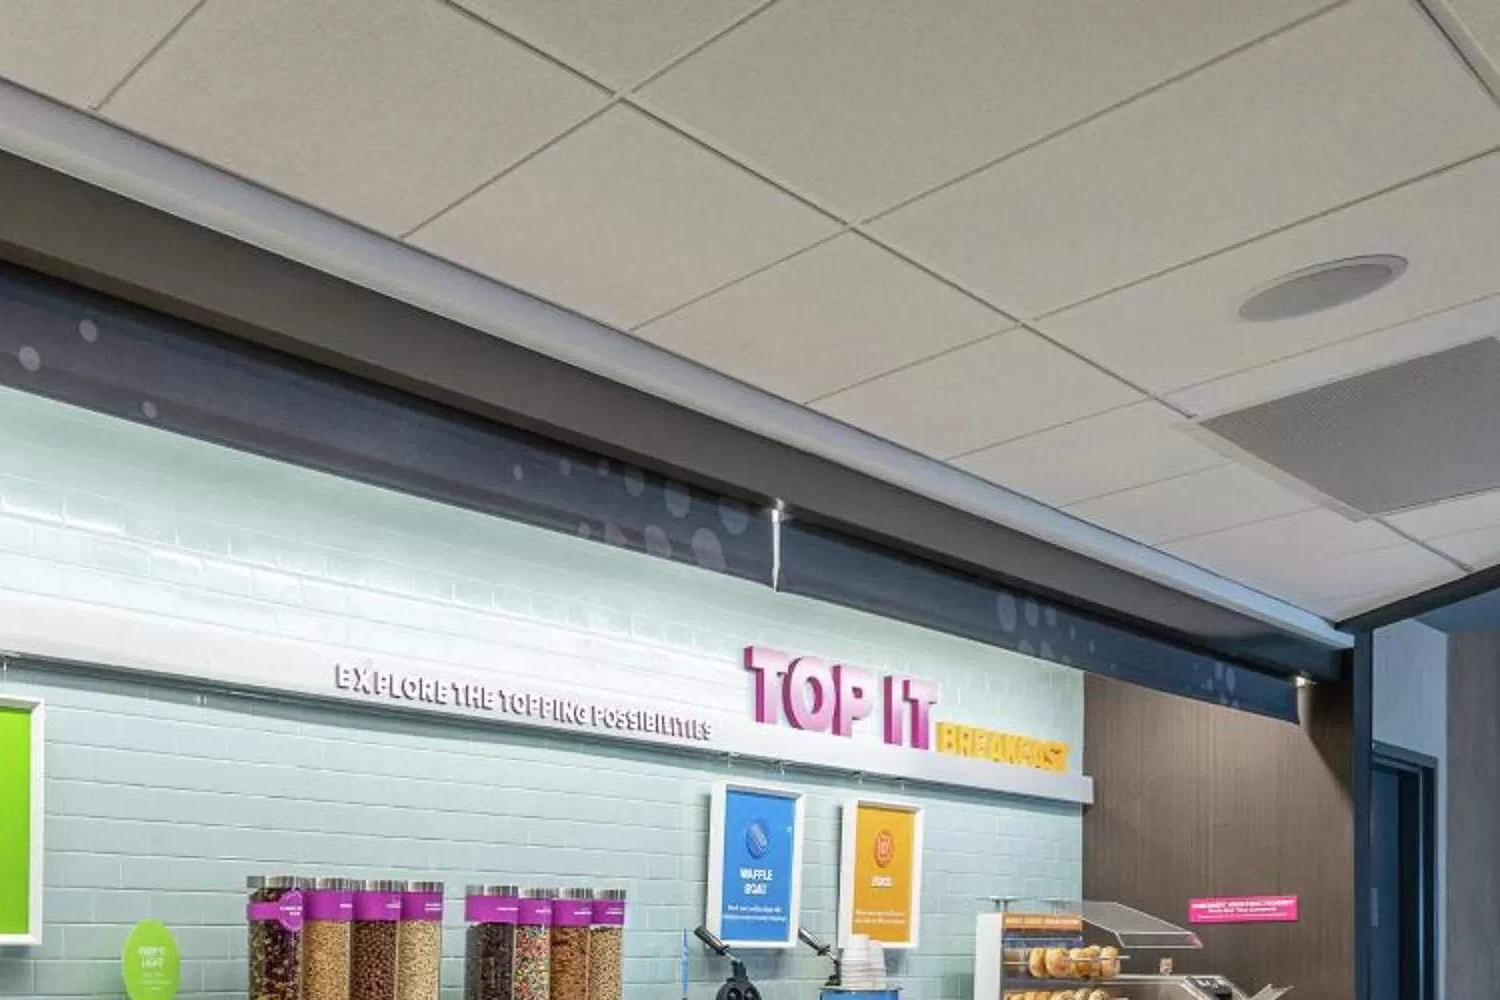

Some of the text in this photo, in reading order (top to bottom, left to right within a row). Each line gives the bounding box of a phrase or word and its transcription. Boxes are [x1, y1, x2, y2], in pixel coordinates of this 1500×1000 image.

[334, 662, 713, 742] EXPLORE THE TOPPING POSSIBILITIES
[743, 645, 939, 751] TOP IT
[936, 720, 1071, 776] BREAKFAST
[740, 867, 773, 881] WAFFLE
